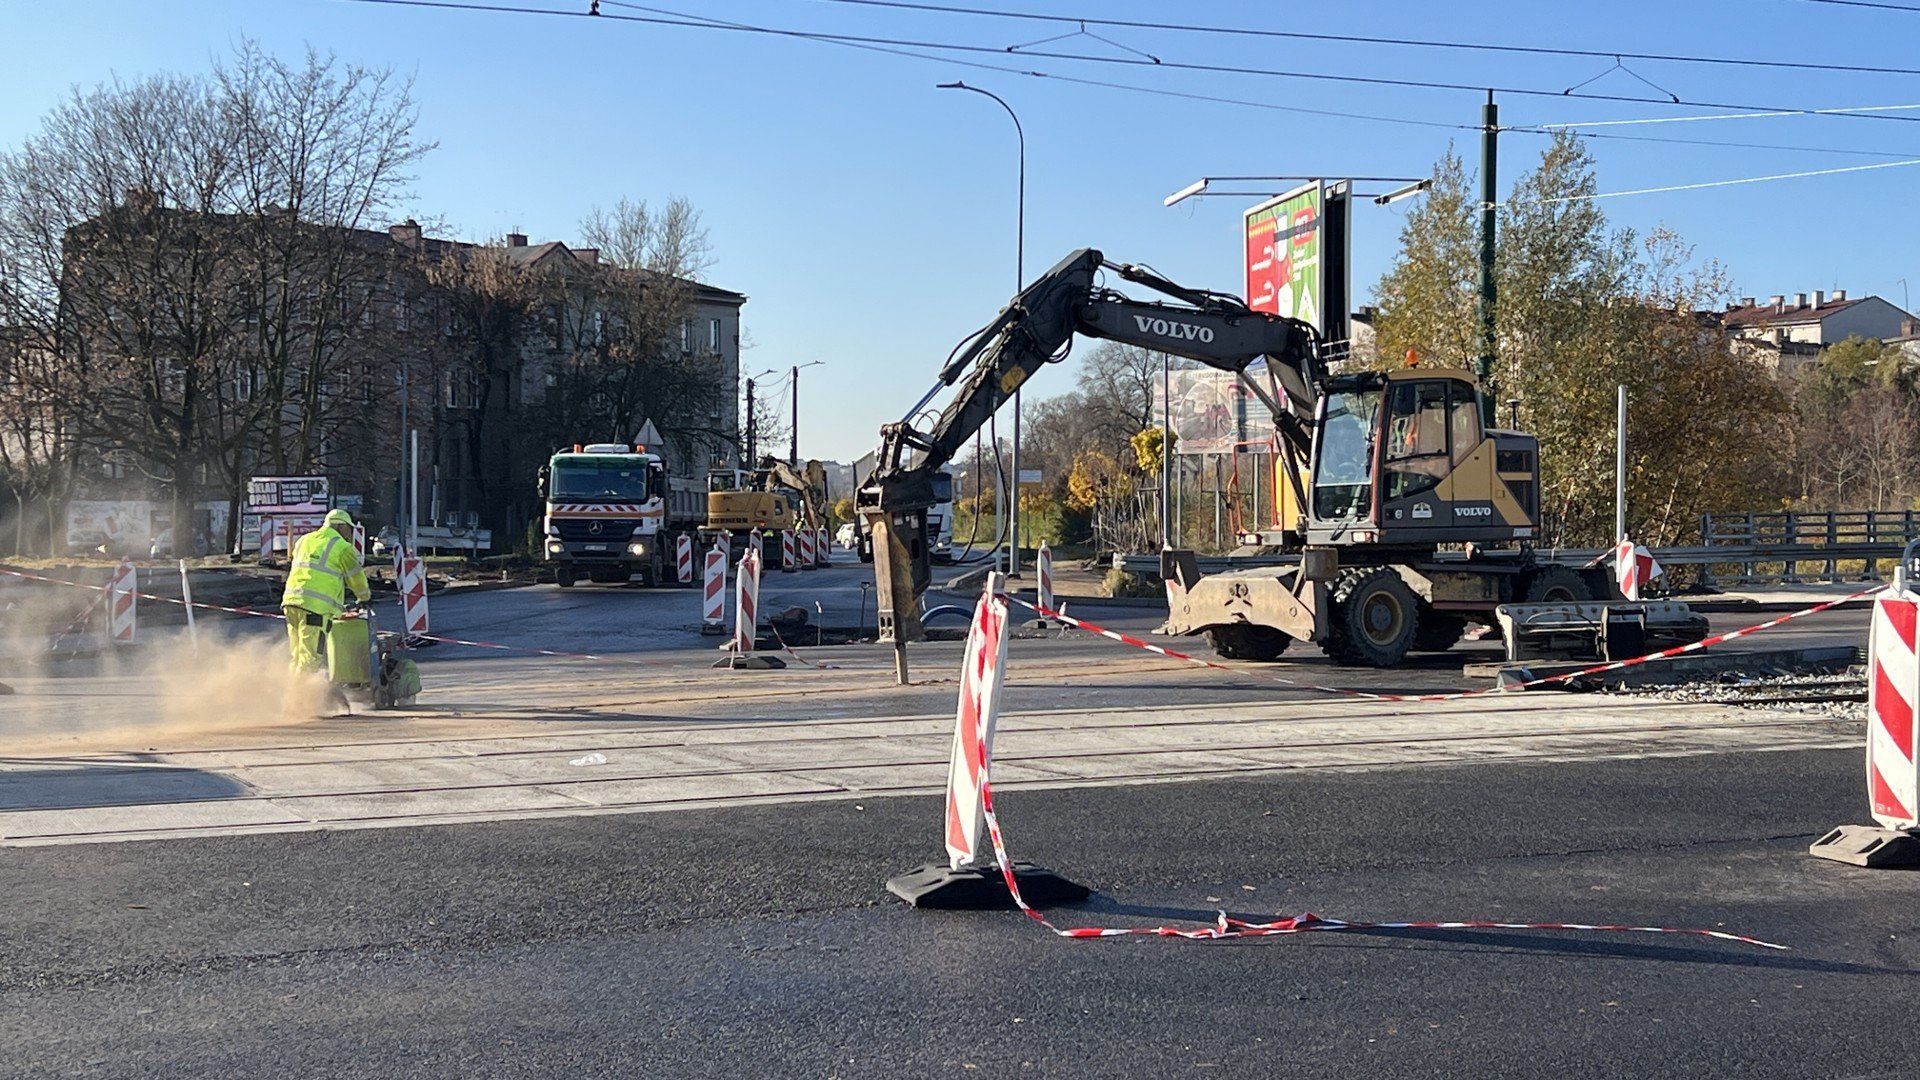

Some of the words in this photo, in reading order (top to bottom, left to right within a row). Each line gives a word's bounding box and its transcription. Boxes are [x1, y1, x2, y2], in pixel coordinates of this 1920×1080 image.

[1133, 315, 1214, 343] VOLVO
[247, 481, 277, 494] SKLAD
[249, 493, 277, 505] OPALU
[1454, 507, 1492, 516] VOLVO
